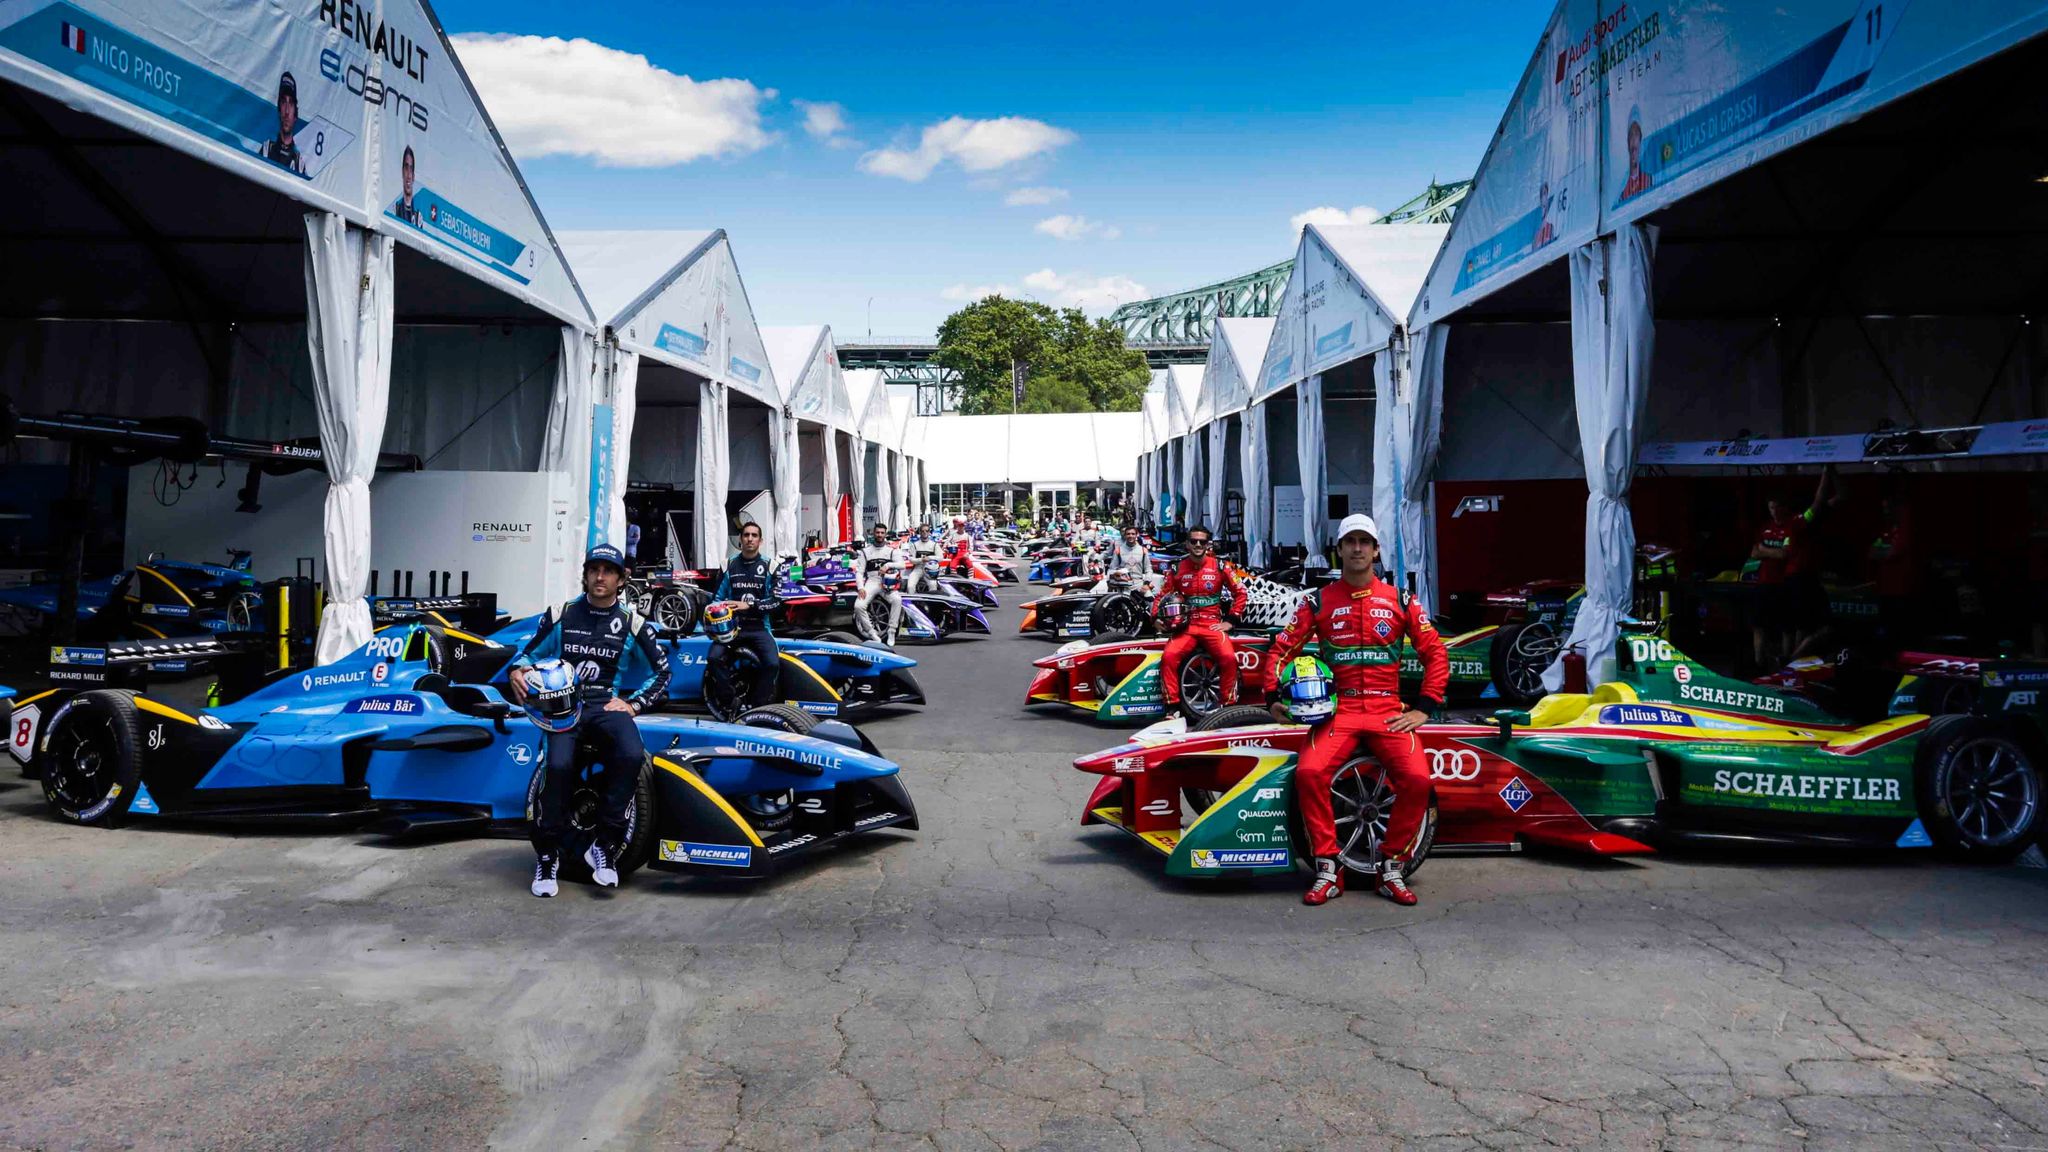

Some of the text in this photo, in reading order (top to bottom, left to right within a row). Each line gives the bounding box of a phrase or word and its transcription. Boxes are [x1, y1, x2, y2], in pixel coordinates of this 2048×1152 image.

[1866, 4, 1882, 44] 11
[320, 0, 429, 84] RENAULT
[1568, 2, 1627, 68] Audi Sport
[1570, 11, 1660, 97] ABT SCHAEFFLER
[92, 36, 181, 97] NICO PROST
[1617, 77, 1623, 91] E
[1630, 50, 1661, 82] TEAM
[1677, 94, 1757, 154] LUCAS DI GRASSI
[315, 131, 324, 156] 8
[440, 211, 472, 240] SEBASTIEN
[529, 250, 535, 267] 9
[283, 445, 321, 458] S.BUEMI
[1451, 495, 1504, 519] ABT
[473, 522, 532, 532] RENAULT
[640, 598, 650, 610] 37
[1331, 606, 1353, 619] ABT
[1538, 611, 1557, 622] ABT
[366, 637, 404, 657] PRO
[564, 643, 619, 659] RENAULT
[1633, 640, 1671, 662] DIG
[858, 654, 884, 663] MILLE
[1334, 651, 1389, 661] SCHAEFFLER
[50, 672, 105, 681] RICHARD MILLE
[314, 671, 367, 686] RENAULT
[1678, 668, 1687, 680] E
[539, 686, 576, 700] RENAULT
[1681, 685, 1785, 713] SCHAEFFLER
[1893, 695, 1917, 705] ABT
[2002, 690, 2040, 710] ABT
[358, 699, 415, 712] Julius Bär
[802, 704, 836, 712] MICHELIN
[1128, 705, 1163, 713] MICHELIN
[1619, 708, 1683, 723] Julius Bär
[16, 718, 31, 747] 8
[1228, 739, 1271, 749] KUKA
[736, 739, 842, 770] RICHARD MILLE
[1714, 770, 1901, 801] SCHAEFFLER
[1252, 788, 1284, 802] ABT
[1505, 790, 1527, 800] LGT
[690, 848, 749, 860] MICHELIN
[1221, 853, 1285, 862] MICHELIN
